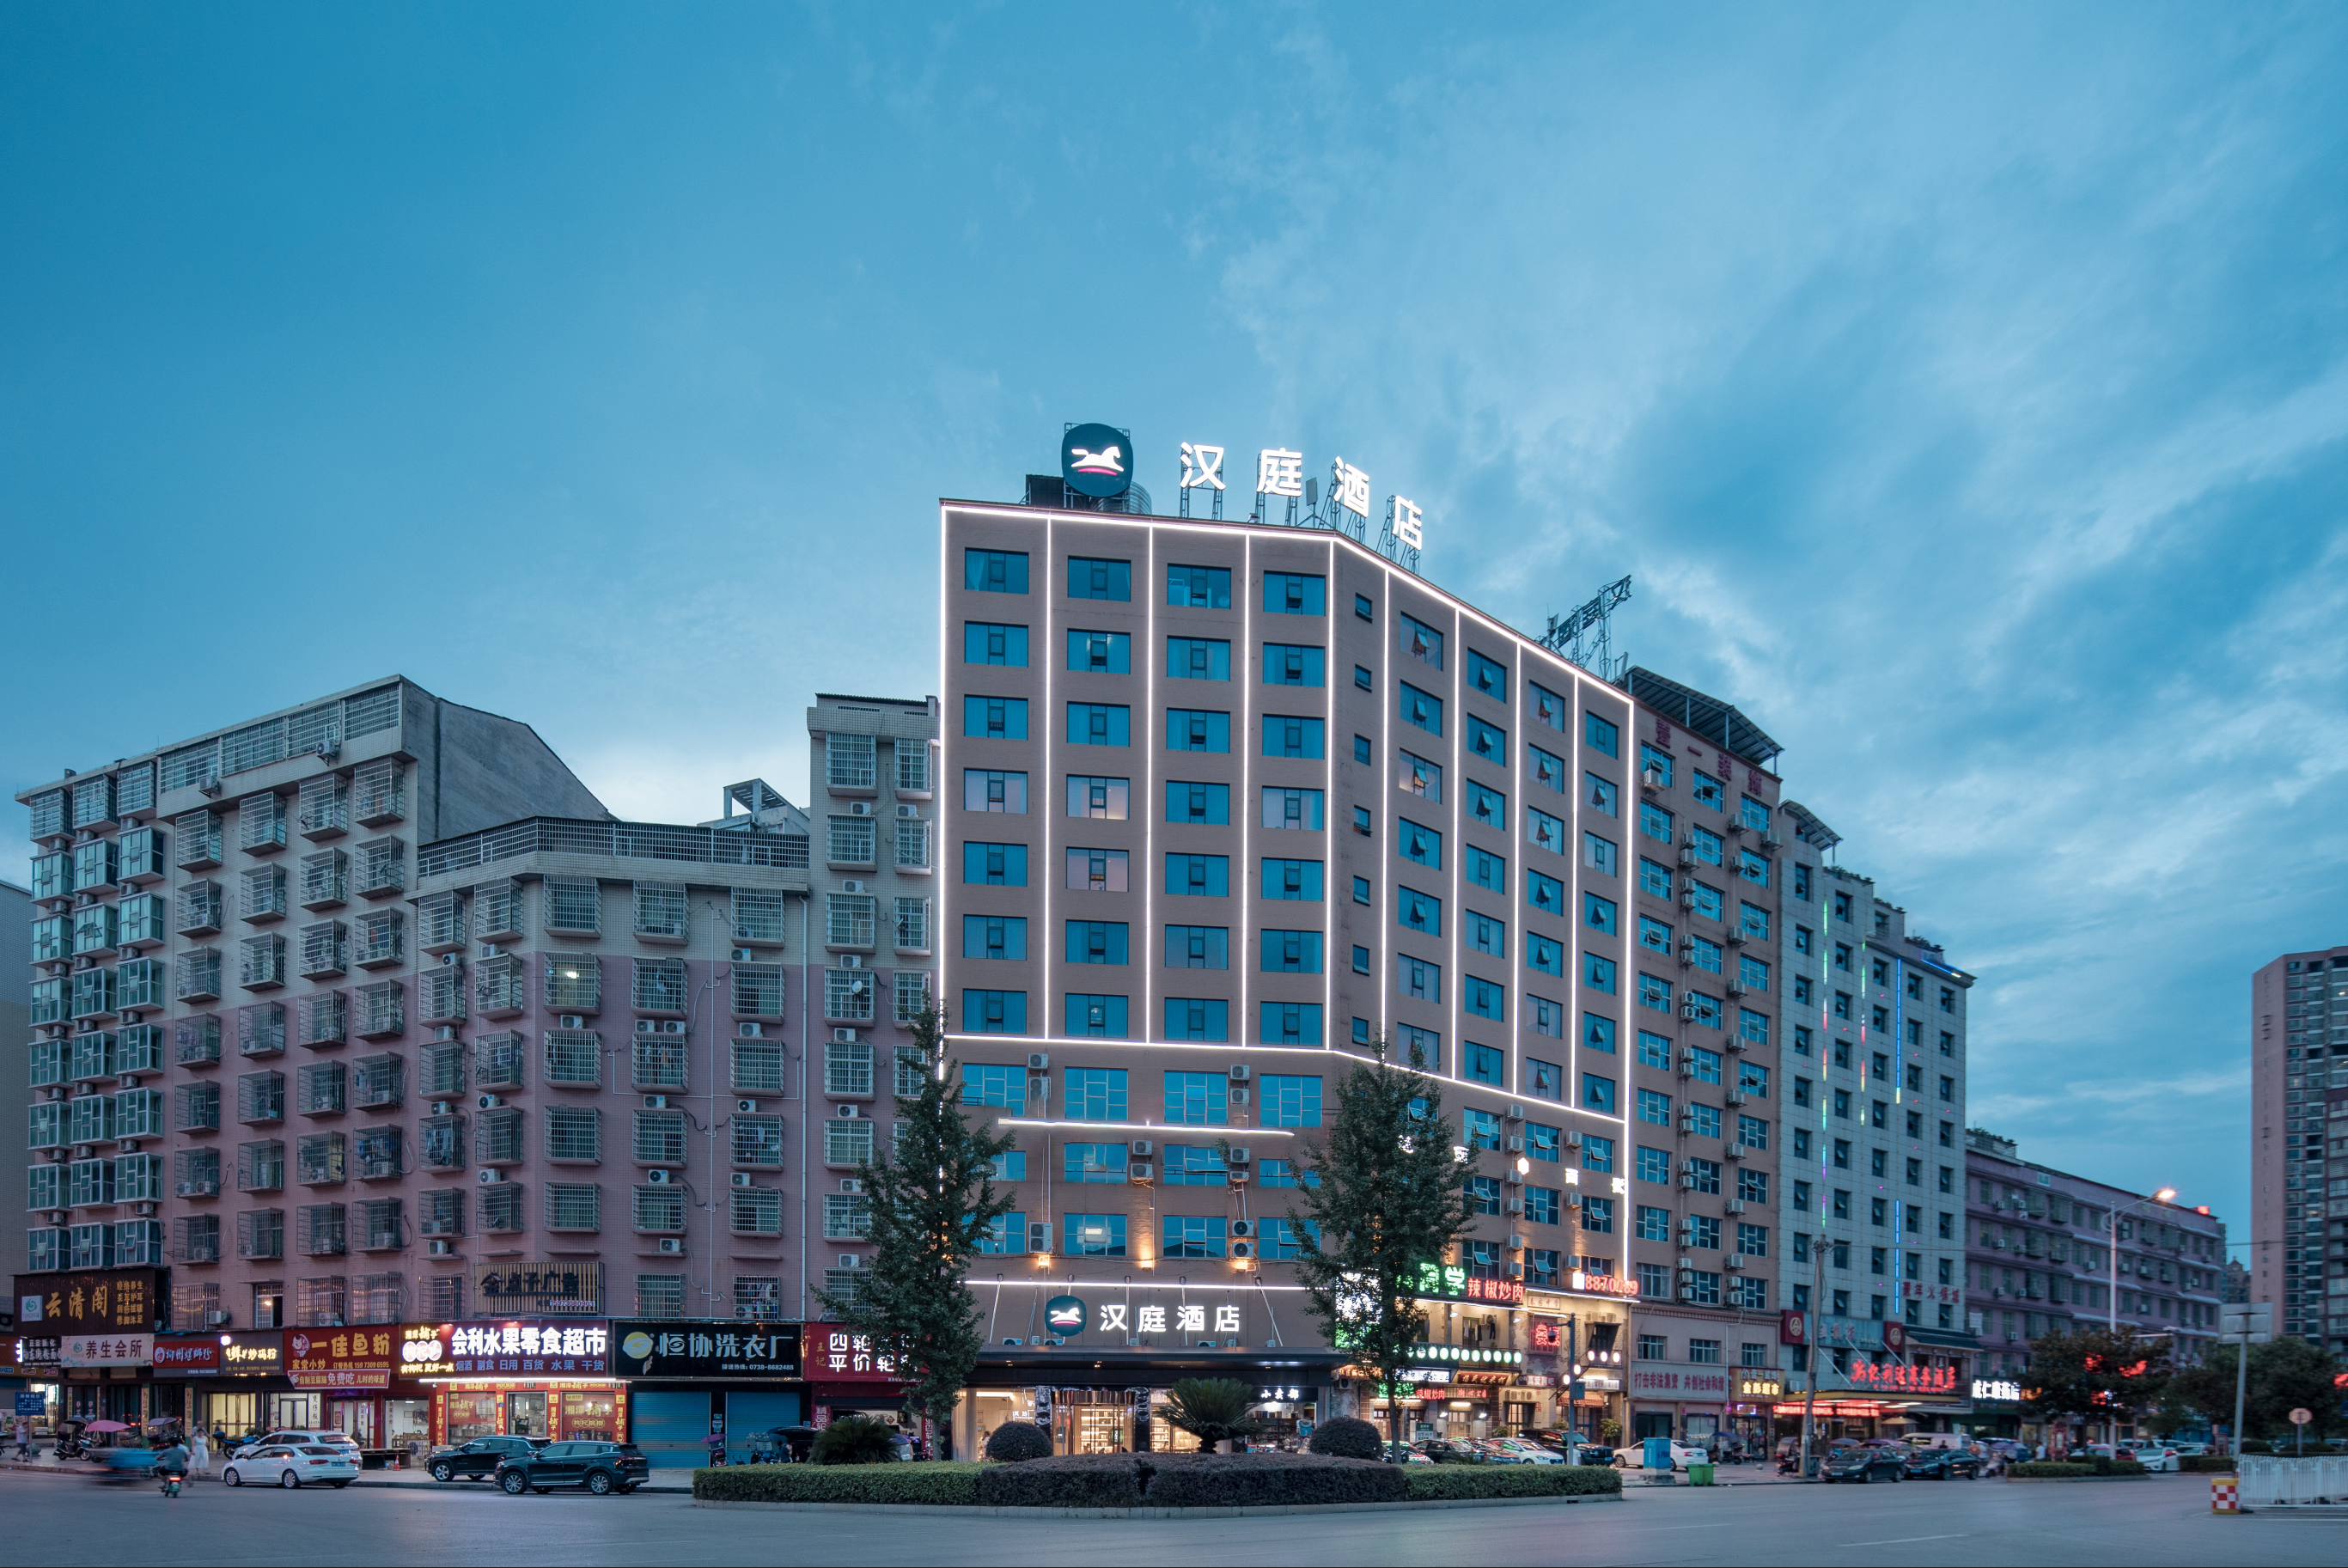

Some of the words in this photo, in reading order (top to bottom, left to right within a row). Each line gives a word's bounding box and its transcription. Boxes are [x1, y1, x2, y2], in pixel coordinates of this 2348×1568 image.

[1180, 442, 1423, 551] 汉庭酒店
[1467, 1278, 1524, 1301] 辣椒炒肉
[1585, 1274, 1639, 1296] 8870789
[46, 1285, 109, 1321] 云清阁
[1099, 1304, 1241, 1333] 汉庭酒店
[86, 1339, 143, 1358] 养生会所
[311, 1332, 390, 1358] 一佳鱼粉
[451, 1327, 607, 1357] 会利水果零食超市
[658, 1333, 794, 1359] 恒协洗衣厂
[292, 1358, 326, 1370] 家常小炒
[455, 1359, 473, 1371] 烟酒
[477, 1359, 495, 1370] 副食
[499, 1359, 518, 1371] 日用
[522, 1358, 544, 1371] 百货
[551, 1358, 576, 1371] 水果
[582, 1358, 605, 1371] 干货
[327, 1372, 355, 1386] 免费吃
[356, 1374, 386, 1384] 儿时的味道
[1634, 1372, 1679, 1389] 打击非法集资
[1684, 1376, 1725, 1392] 共创社会和谐
